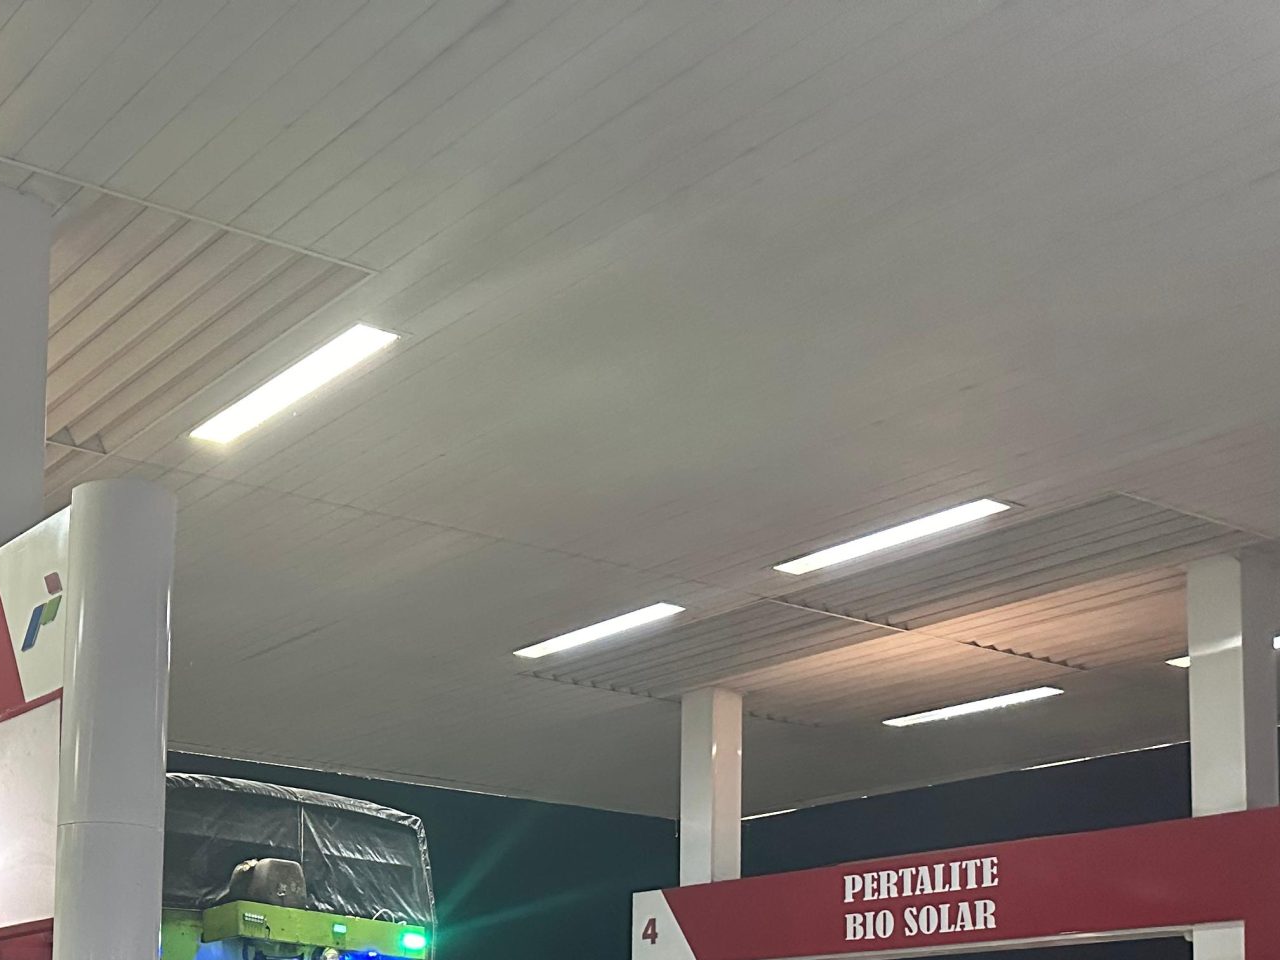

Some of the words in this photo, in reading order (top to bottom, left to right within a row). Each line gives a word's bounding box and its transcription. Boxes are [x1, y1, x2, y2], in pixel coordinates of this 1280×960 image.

[843, 856, 999, 903] PERTALITE
[642, 918, 658, 944] 4
[845, 910, 895, 941] BIO
[904, 899, 997, 937] SOLAR
